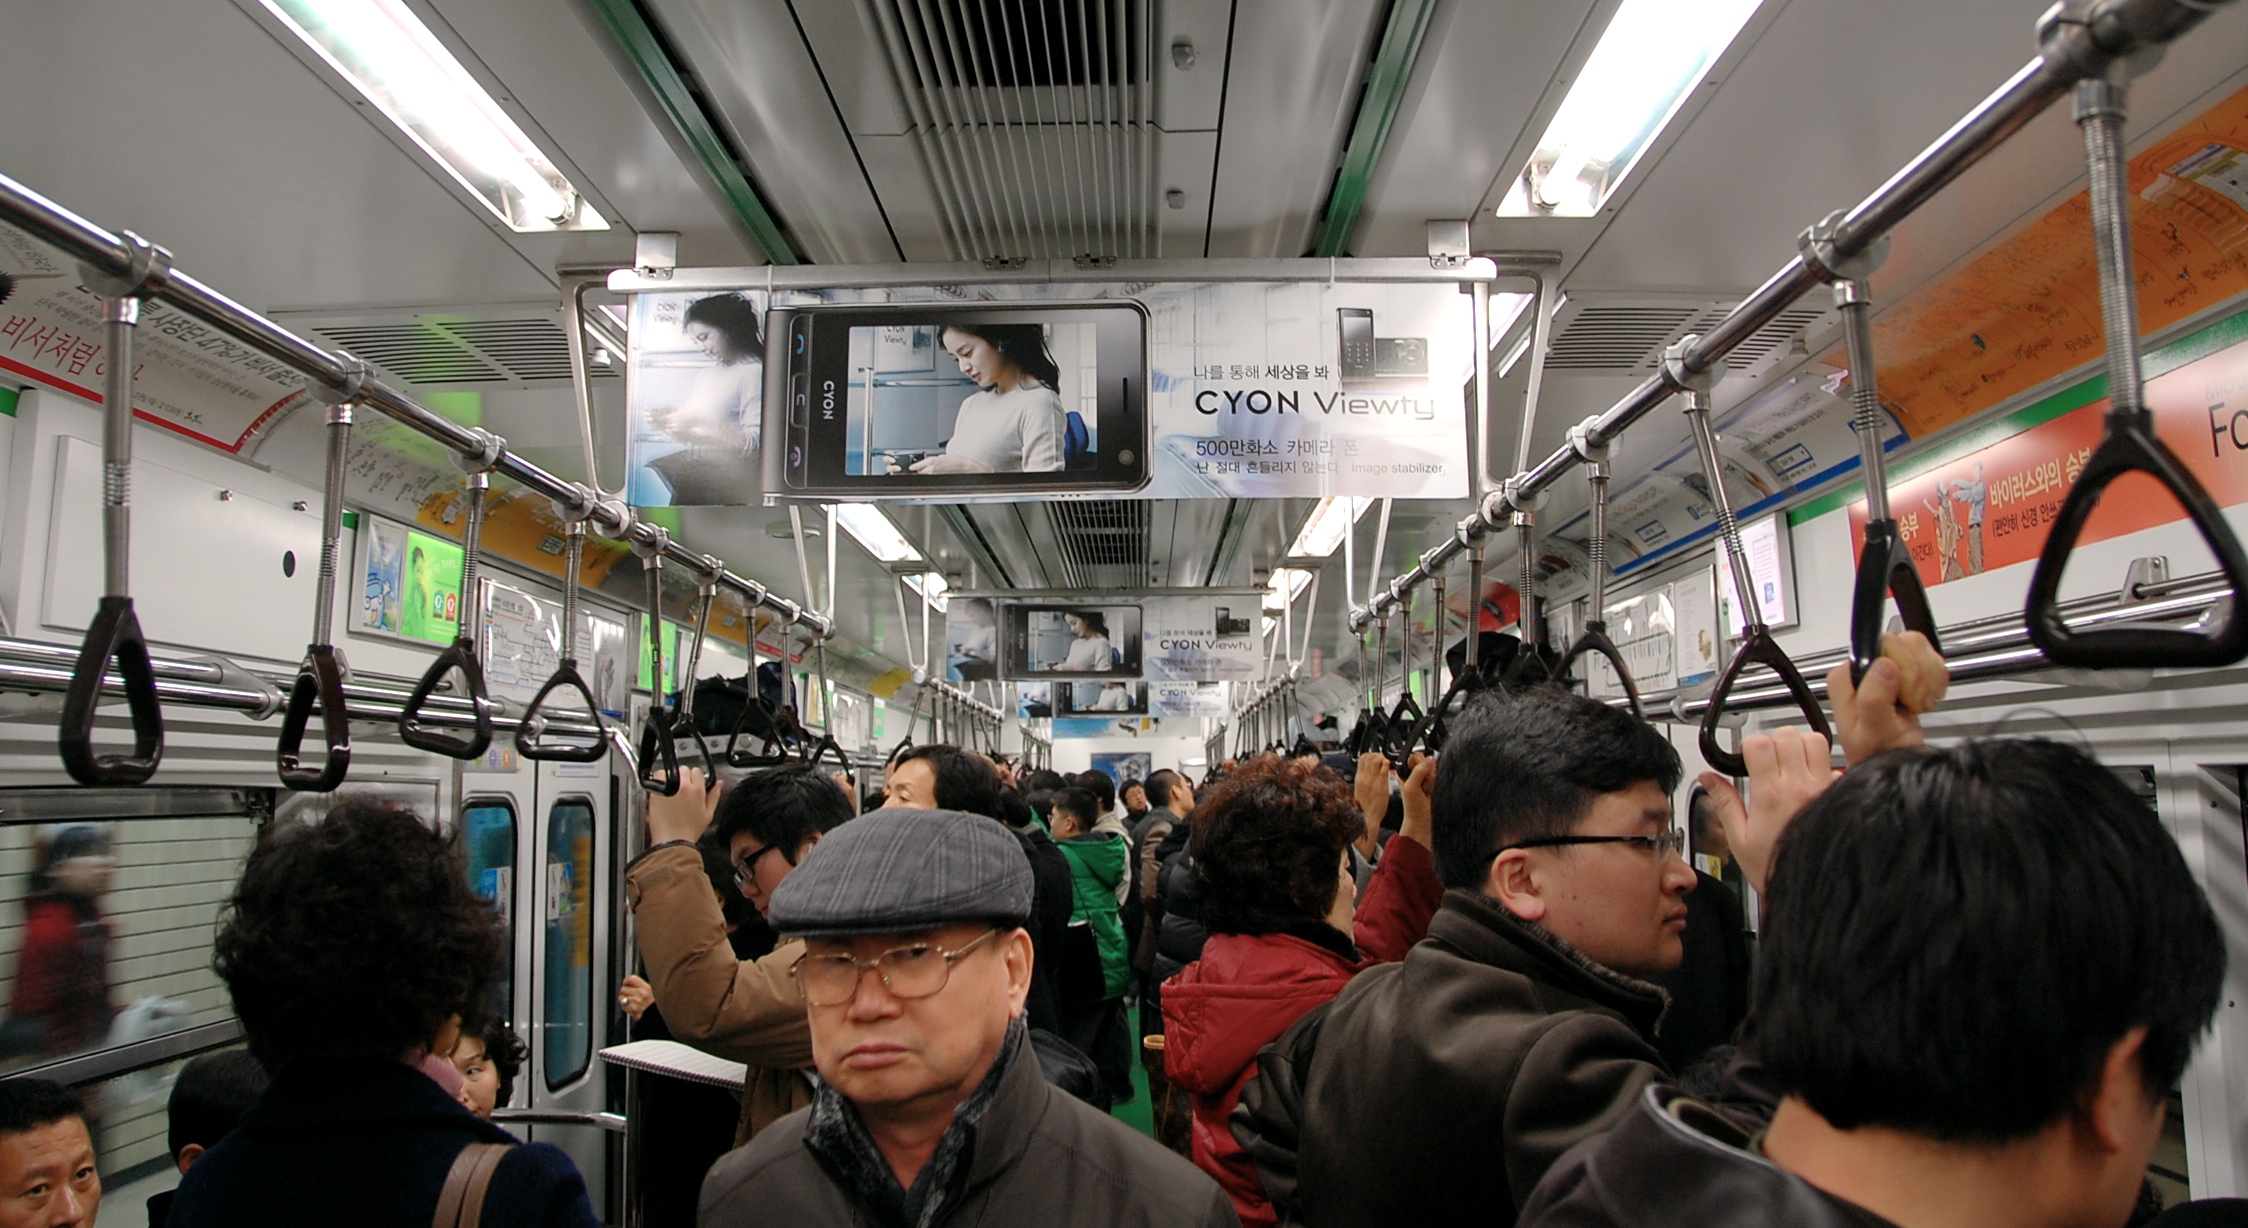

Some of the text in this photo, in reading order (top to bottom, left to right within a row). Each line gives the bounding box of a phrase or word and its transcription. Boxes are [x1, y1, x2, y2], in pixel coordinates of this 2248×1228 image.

[149, 313, 210, 343] 사장단
[2, 315, 101, 375] 비서처럼
[1193, 364, 1330, 381] 나를 통해 세상을 봐
[822, 380, 835, 420] CYON
[1195, 390, 1435, 420] CYON Viewty
[1196, 439, 1360, 457] 500만화소 카메라 폰
[1196, 461, 1210, 475] 난
[1215, 461, 1241, 475] 절대
[1245, 461, 1297, 475] 흔들리지
[1302, 461, 1339, 475] 않는다
[1989, 458, 2063, 509] 바이러스와의
[1900, 511, 1919, 542] 승부
[2021, 508, 2039, 529] 신경
[2040, 500, 2066, 523] 안쓰
[1160, 639, 1252, 652] CYON Viewty
[1160, 689, 1187, 697] CYON
